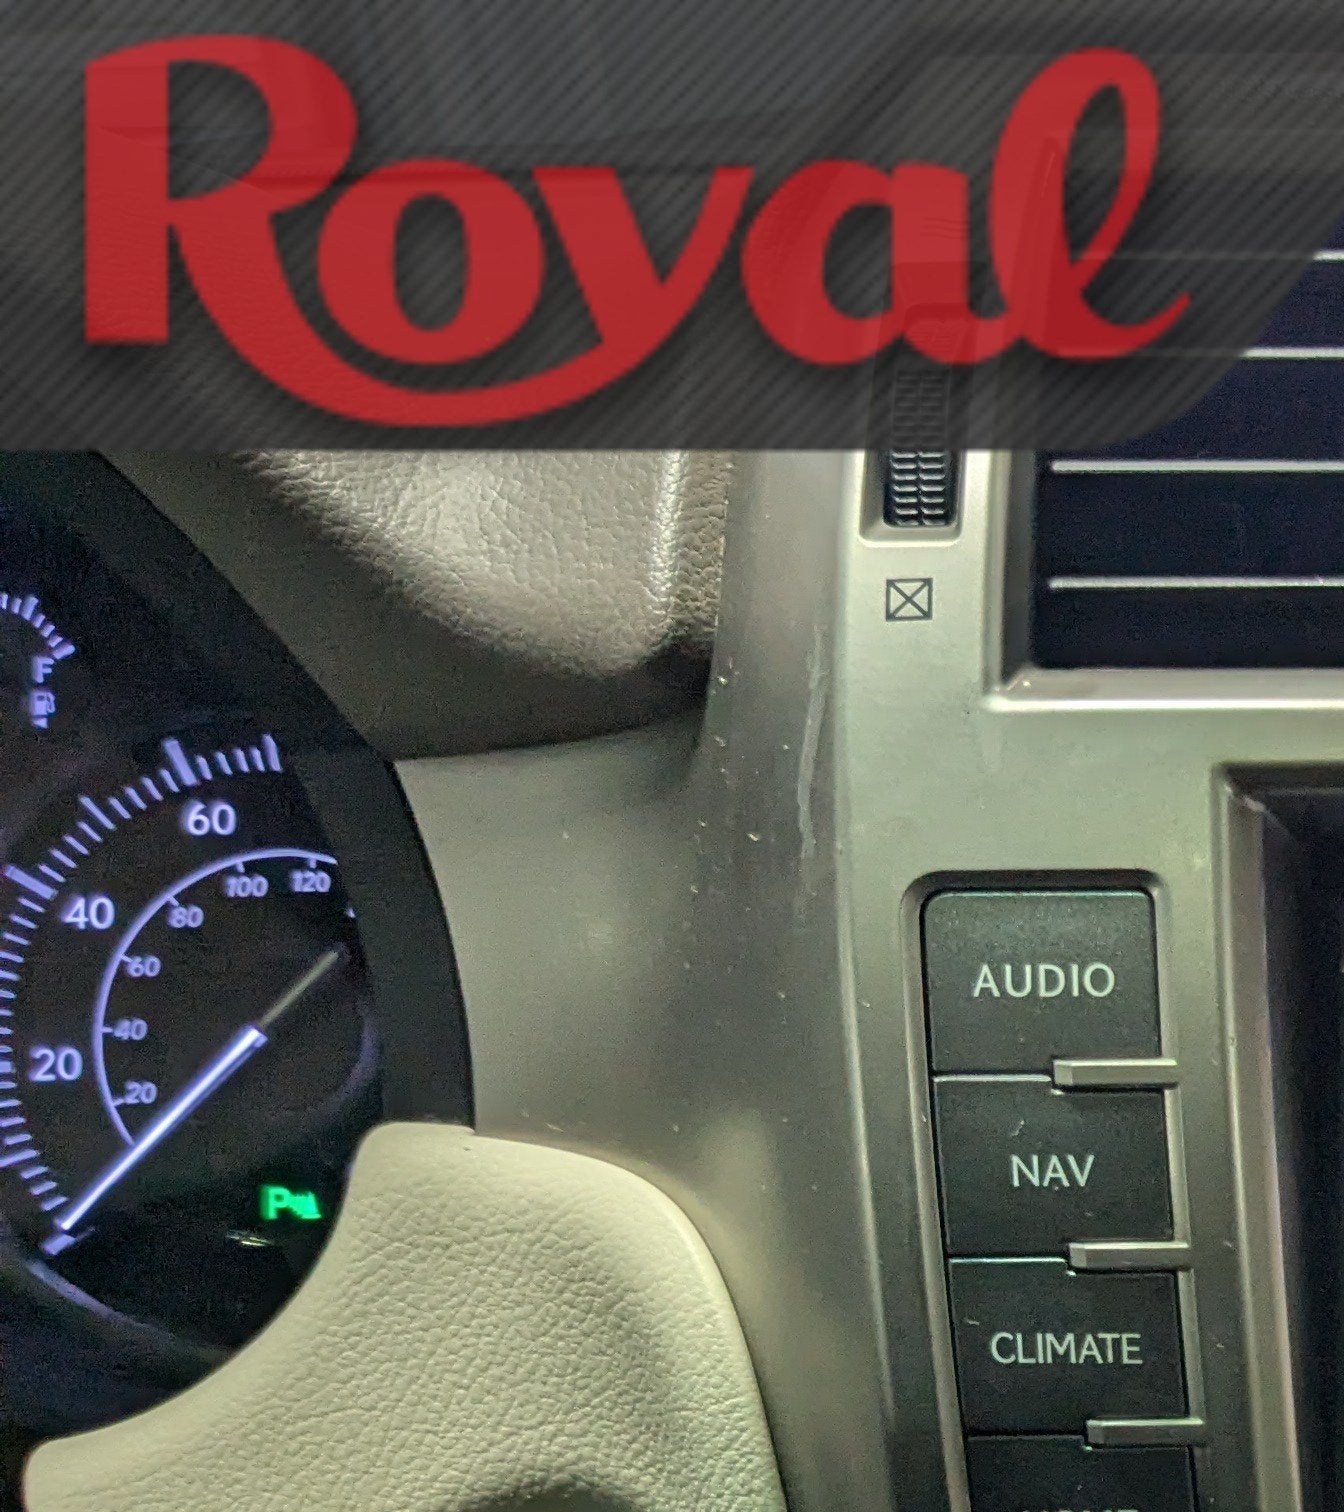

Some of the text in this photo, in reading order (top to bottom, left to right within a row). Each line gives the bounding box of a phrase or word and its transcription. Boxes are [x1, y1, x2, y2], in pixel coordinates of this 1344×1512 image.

[32, 655, 55, 683] F
[185, 800, 237, 836] 60
[225, 875, 269, 898] 100
[292, 870, 332, 893] 120
[65, 896, 116, 930] 40
[167, 905, 205, 928] 80
[126, 955, 162, 978] 60
[972, 962, 1116, 998] AUDIO
[113, 1018, 149, 1041] 40
[29, 1045, 84, 1082] 20
[125, 1081, 158, 1104] 20
[1010, 1153, 1095, 1188] NAV
[989, 1331, 1144, 1365] CLIMATE
